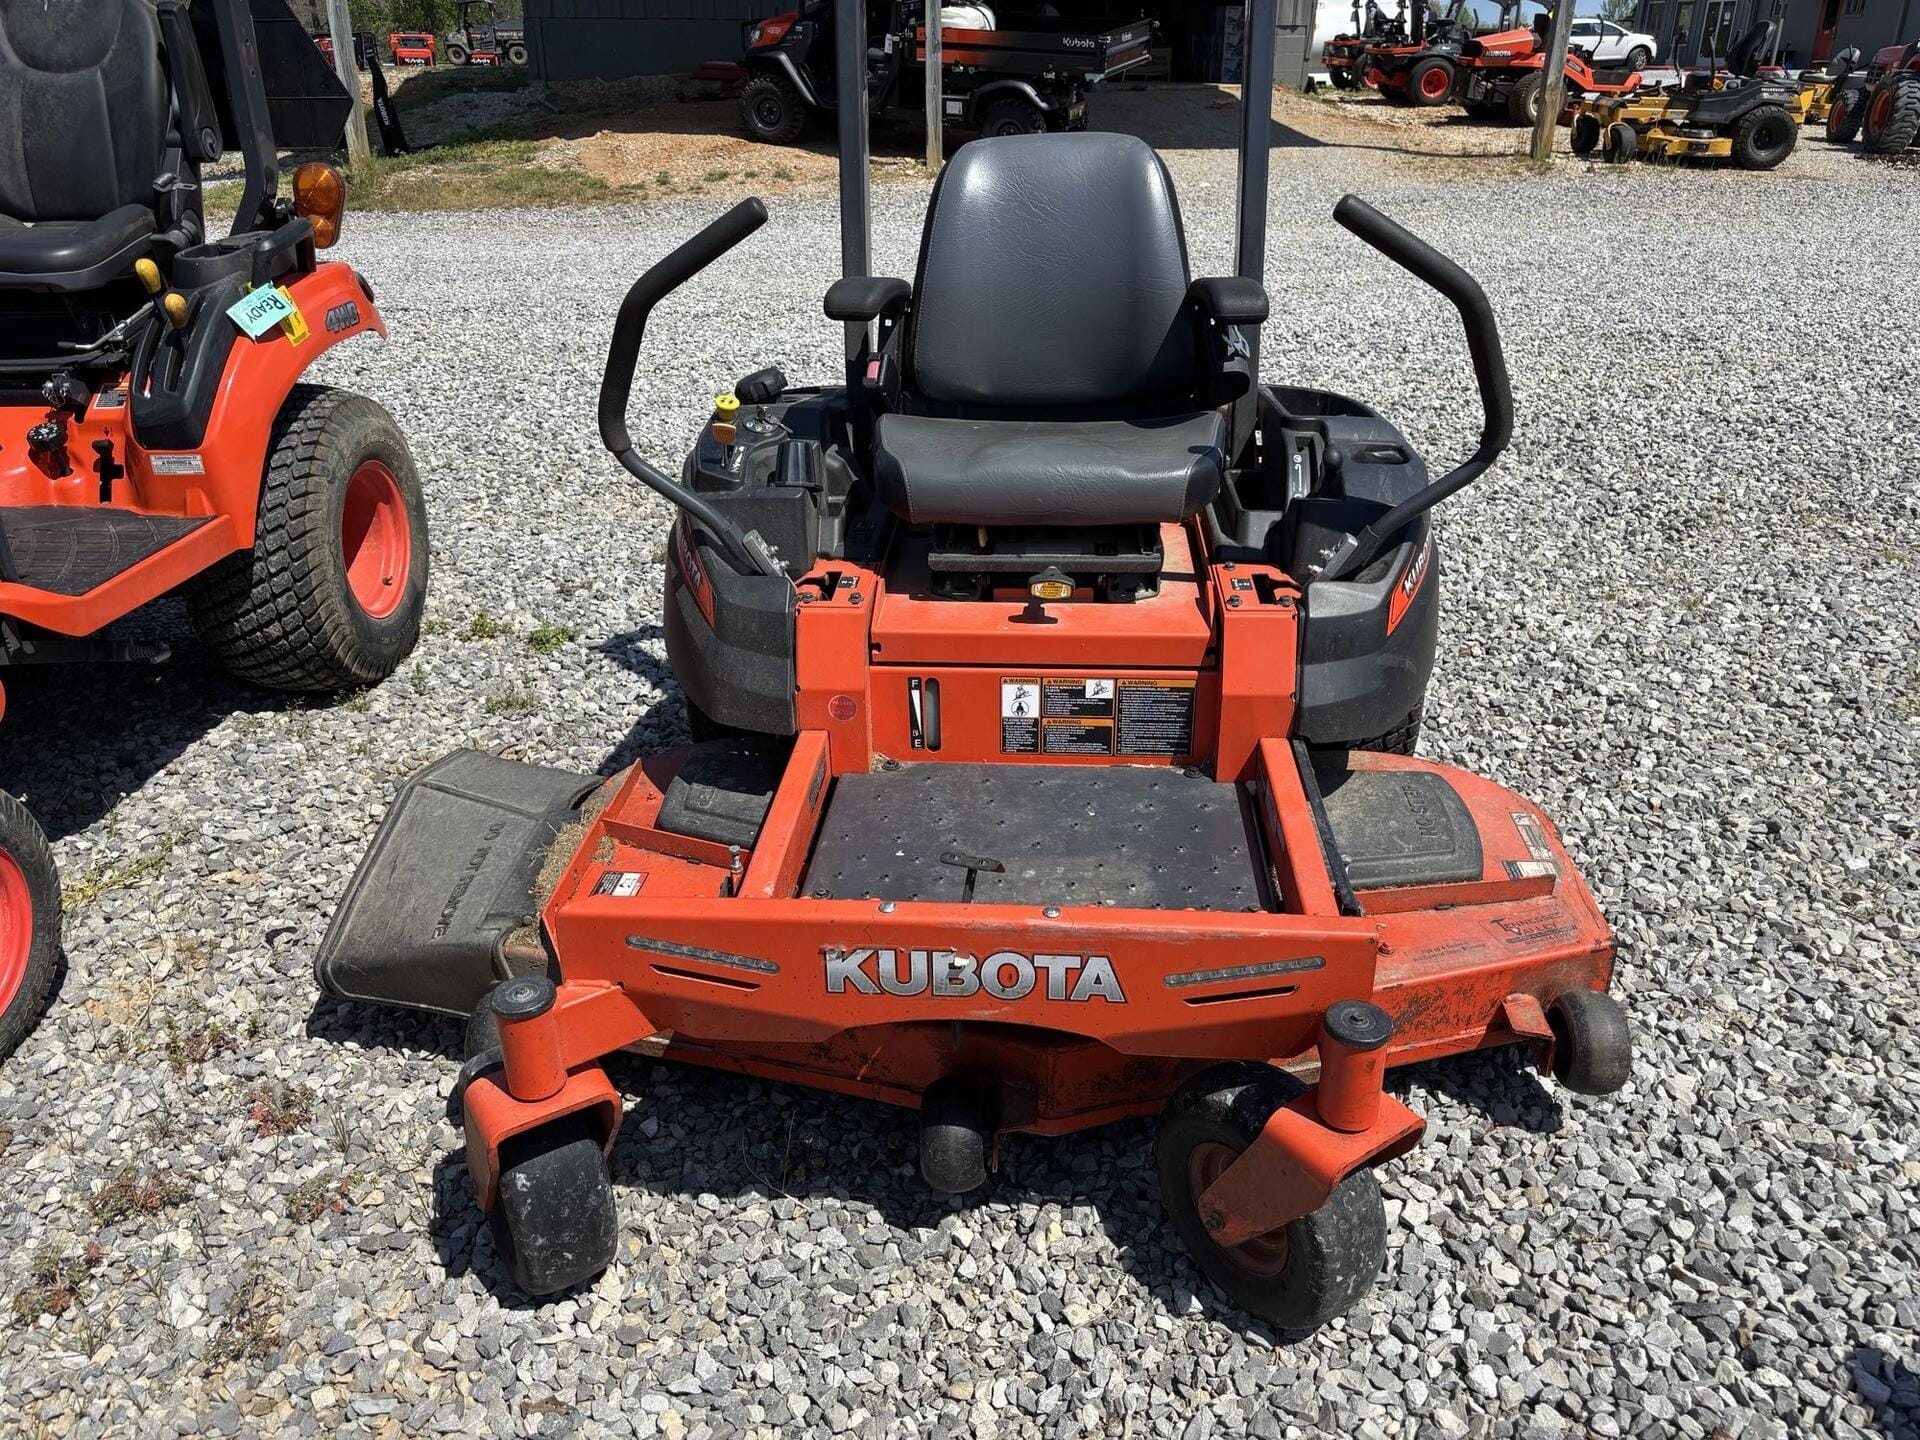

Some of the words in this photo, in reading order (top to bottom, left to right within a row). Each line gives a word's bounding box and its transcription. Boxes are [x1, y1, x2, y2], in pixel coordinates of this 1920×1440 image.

[1062, 36, 1095, 48] Kubota
[1484, 49, 1512, 58] KUBOTA
[377, 97, 391, 126] KUBOTA
[245, 293, 286, 324] READY
[325, 301, 360, 333] 4WD
[911, 680, 919, 689] F
[914, 739, 922, 747] E
[825, 946, 1128, 1003] KUBOTA
